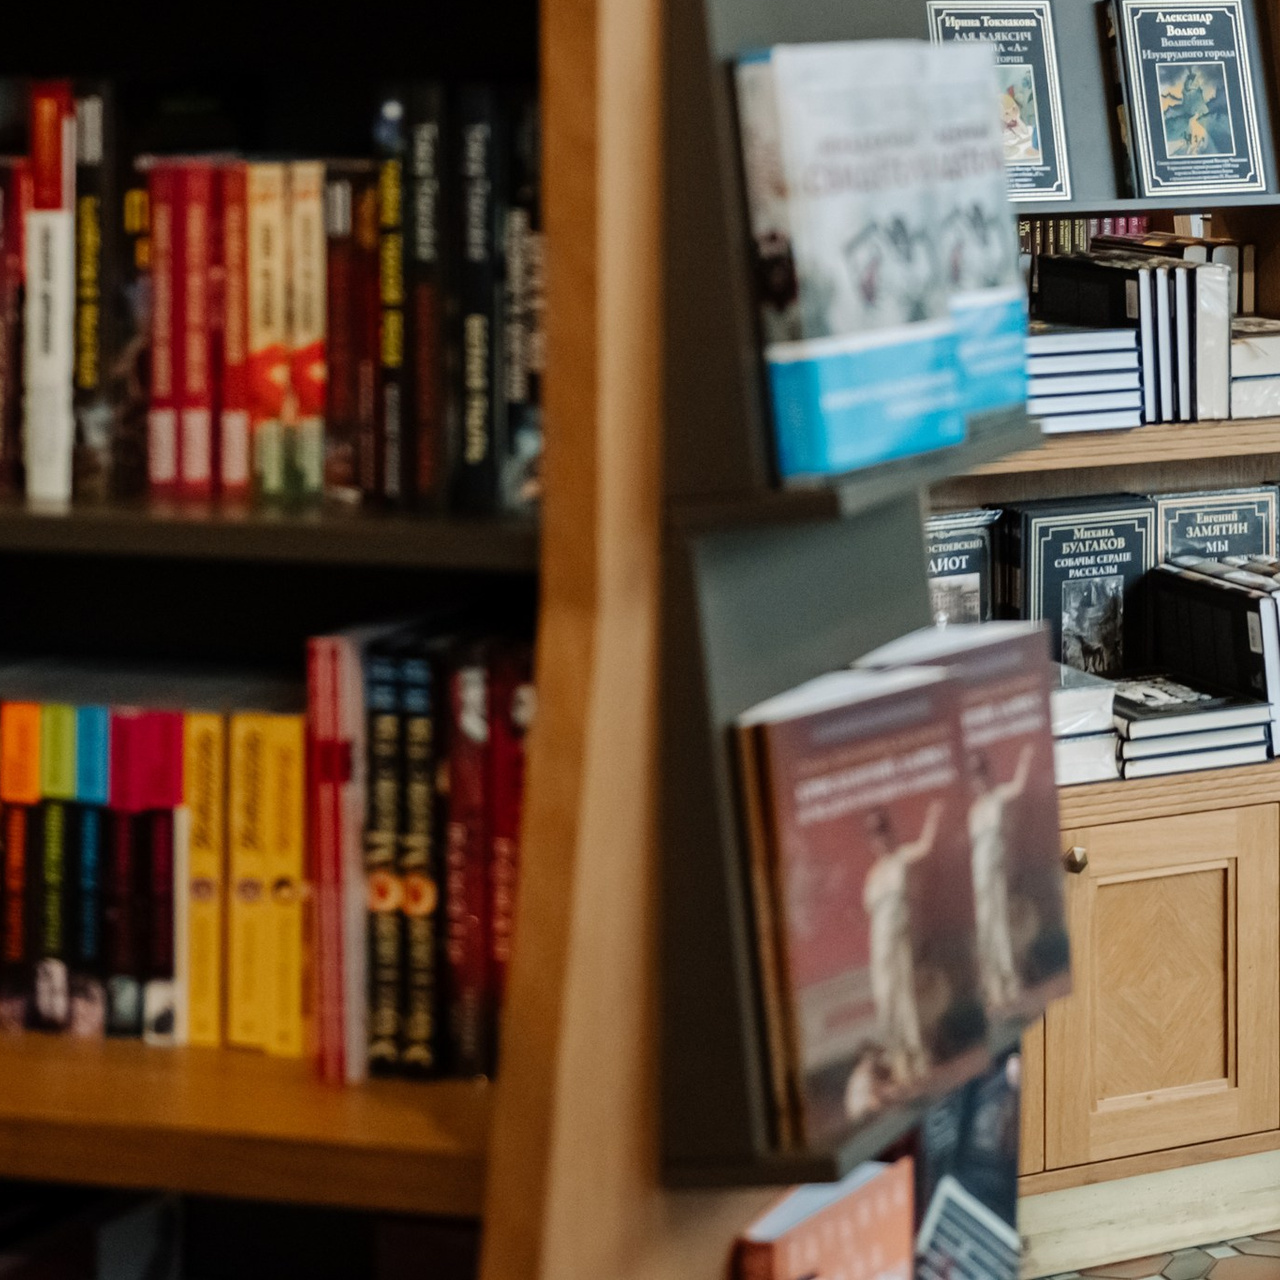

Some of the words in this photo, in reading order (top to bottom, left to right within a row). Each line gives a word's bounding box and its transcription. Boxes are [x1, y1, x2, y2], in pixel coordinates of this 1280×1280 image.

[945, 16, 980, 30] Ирина
[980, 16, 1037, 27] Токмакова
[1156, 12, 1213, 25] Александр
[979, 32, 1032, 41] КЛЯКСИЧ
[1166, 25, 1206, 36] Волков
[1161, 37, 1215, 47] Волшебник
[1142, 50, 1203, 61] Изумрудного
[1205, 50, 1235, 60] города
[1196, 511, 1238, 524] Евгений
[1073, 527, 1115, 540] Михаил
[1186, 522, 1248, 538] ЗАМЯТИН
[926, 539, 983, 553] ОСТОЕВСКИЙ
[1062, 537, 1126, 554] БУЛГАКОВ
[1206, 540, 1229, 553] МЫ
[927, 555, 969, 574] ДИОТ
[1054, 556, 1096, 568] СОБАЧЬЕ
[1097, 552, 1132, 564] СЕРДЦЕ
[1069, 564, 1118, 578] РАССКАЗЫ
